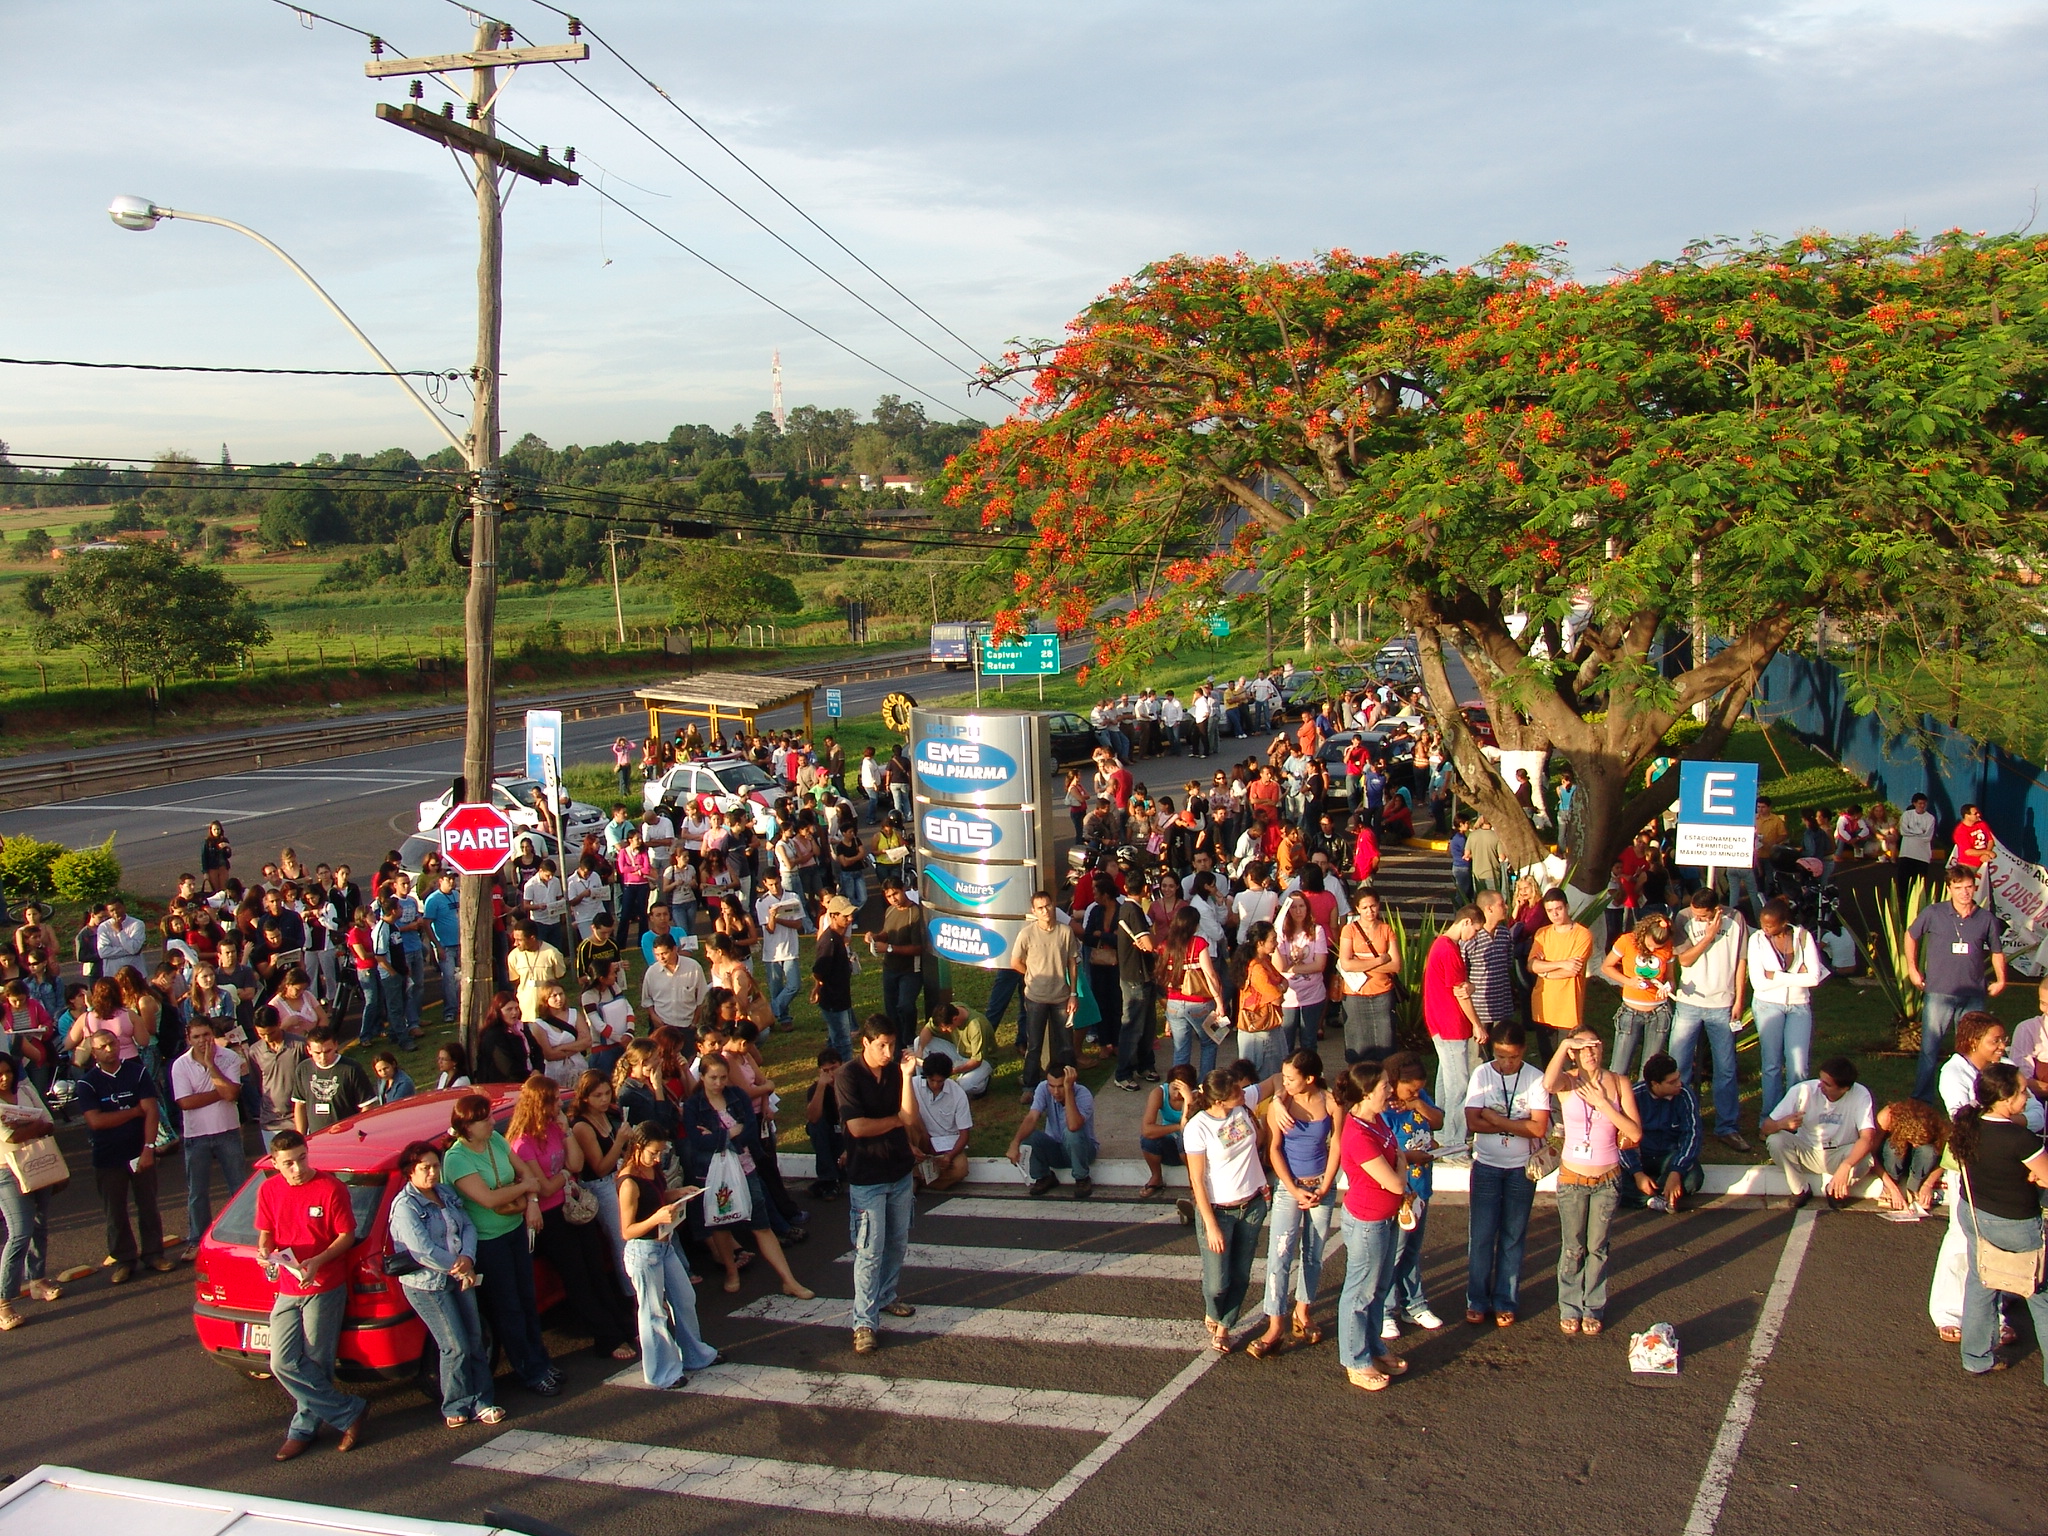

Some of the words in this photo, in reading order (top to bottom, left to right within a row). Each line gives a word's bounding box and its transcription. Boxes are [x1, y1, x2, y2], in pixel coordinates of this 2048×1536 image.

[1043, 638, 1053, 647] 17
[987, 651, 1022, 659] Capivari
[1040, 650, 1054, 658] 28
[1040, 661, 1054, 669] 34
[927, 741, 980, 764] EMS
[917, 759, 944, 777] SIGMA
[946, 764, 1008, 780] PHARMA
[1703, 771, 1737, 815] E
[445, 827, 510, 851] PARE
[1684, 834, 1747, 843] ESTACIONAMENTO
[1696, 842, 1734, 850] PERMITIDO
[955, 881, 995, 896] Nature's
[2001, 881, 2044, 917] custa
[940, 922, 982, 942] SIGMA
[936, 934, 990, 956] PHARMA
